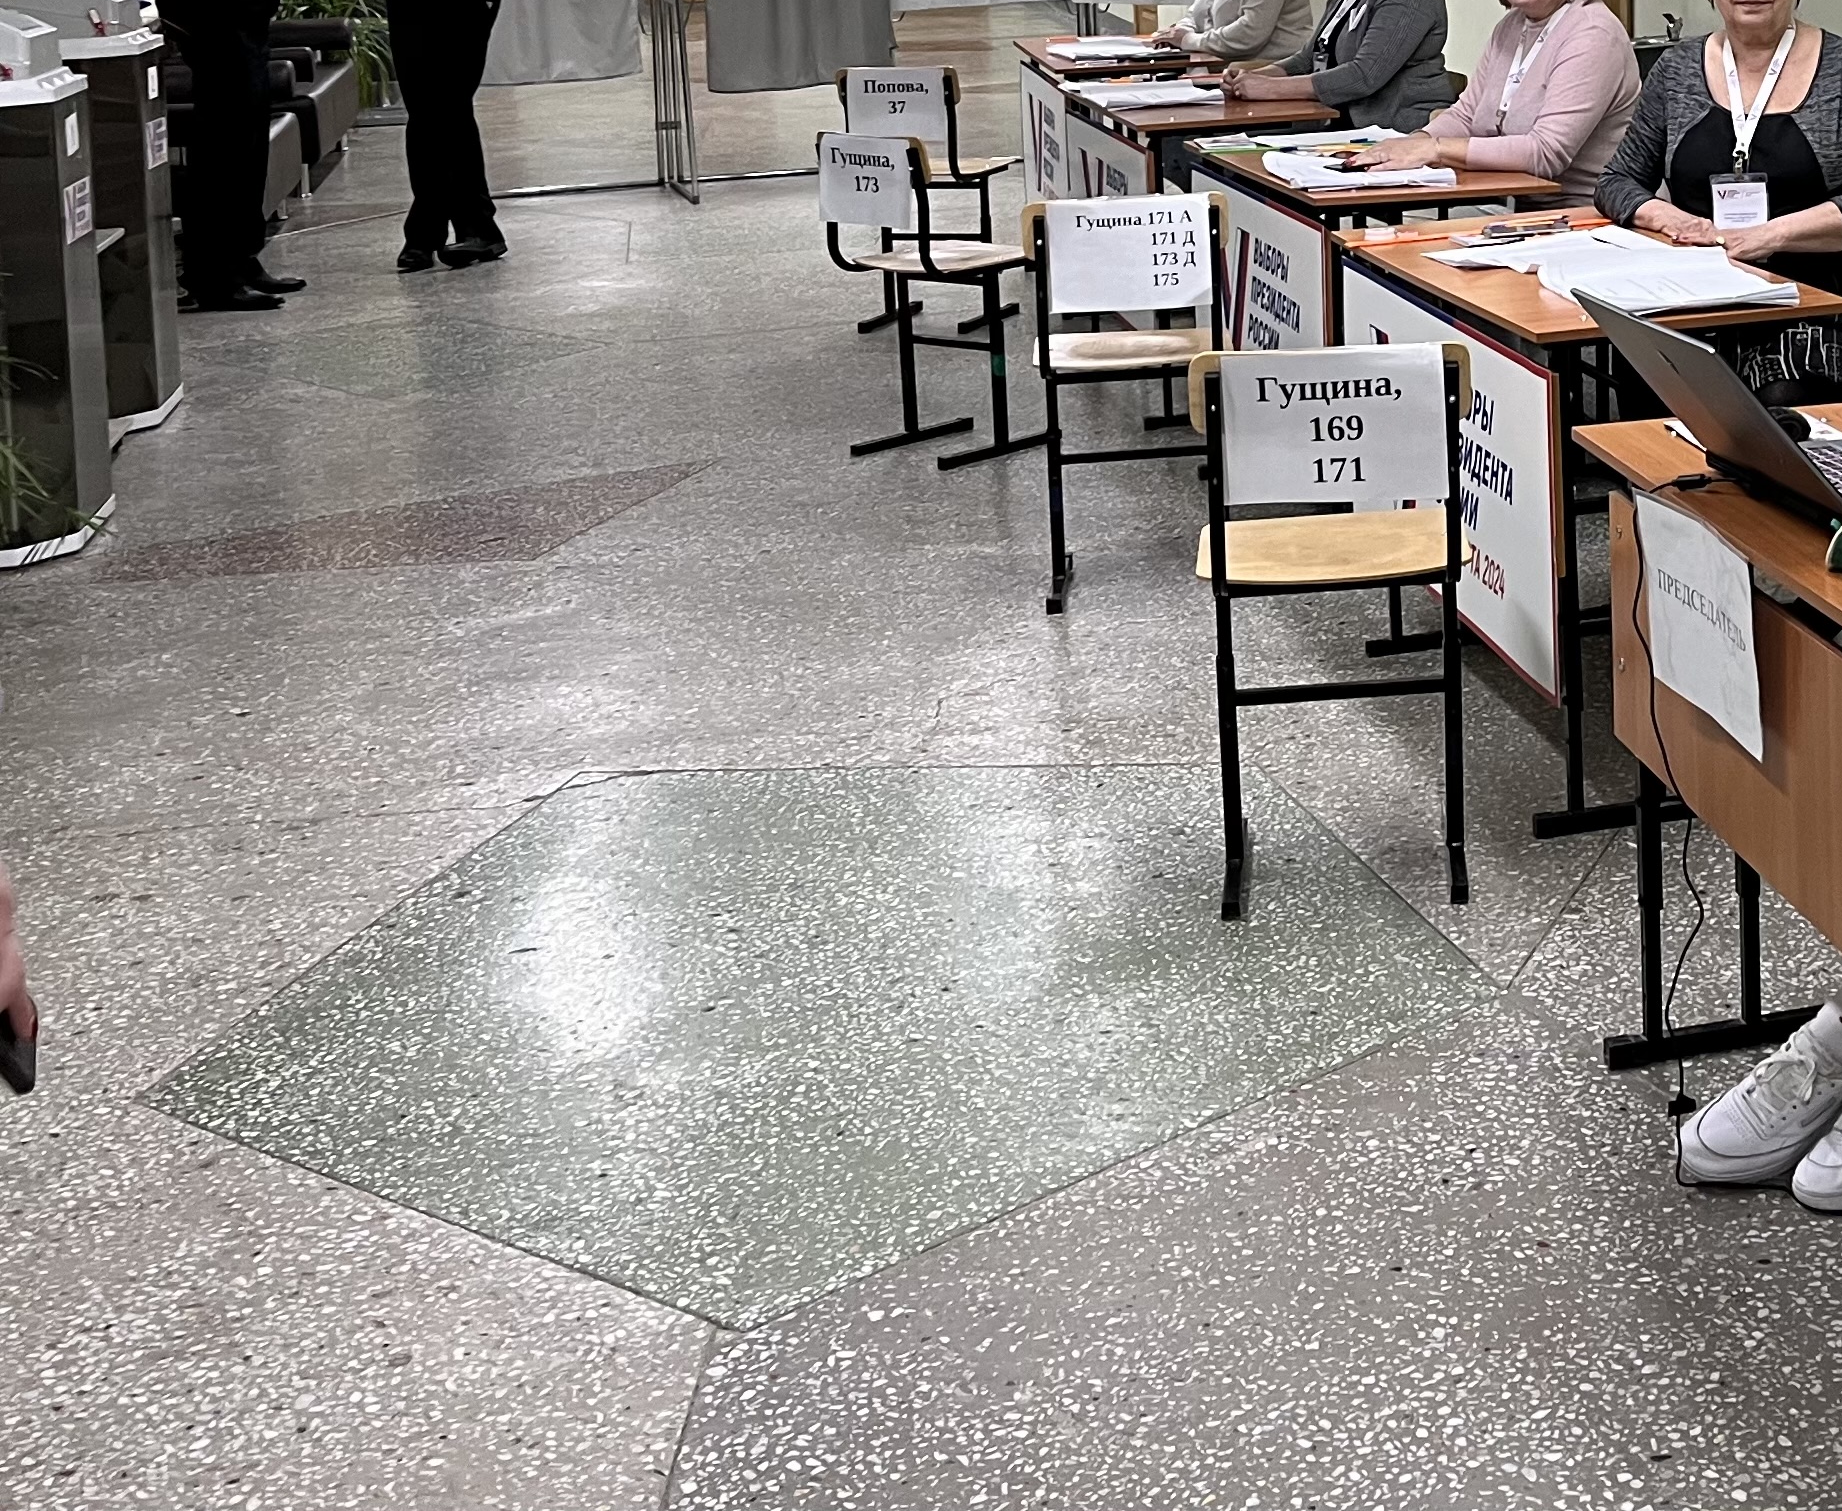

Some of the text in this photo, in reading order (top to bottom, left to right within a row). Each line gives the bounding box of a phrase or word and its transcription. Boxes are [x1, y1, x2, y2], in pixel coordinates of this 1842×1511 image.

[863, 80, 929, 94] Попова,
[888, 101, 906, 114] 37
[830, 147, 895, 171] Гущина,
[855, 175, 879, 193] 173
[1148, 211, 1174, 225] 171
[1180, 210, 1192, 223] А
[1152, 231, 1195, 246] 171 Д
[1153, 251, 1196, 267] 173 Д
[1253, 237, 1290, 283] ВЫБОРЫ
[1153, 273, 1179, 286] 175
[1250, 275, 1300, 333] ПРЕЗИДЕНТА
[1255, 376, 1402, 409] Гущина,
[1309, 414, 1364, 442] 169
[1312, 457, 1366, 483] 171
[1482, 555, 1505, 600] 2024
[1657, 568, 1746, 652] ПРЕДСЕДАТЕЛЬ
